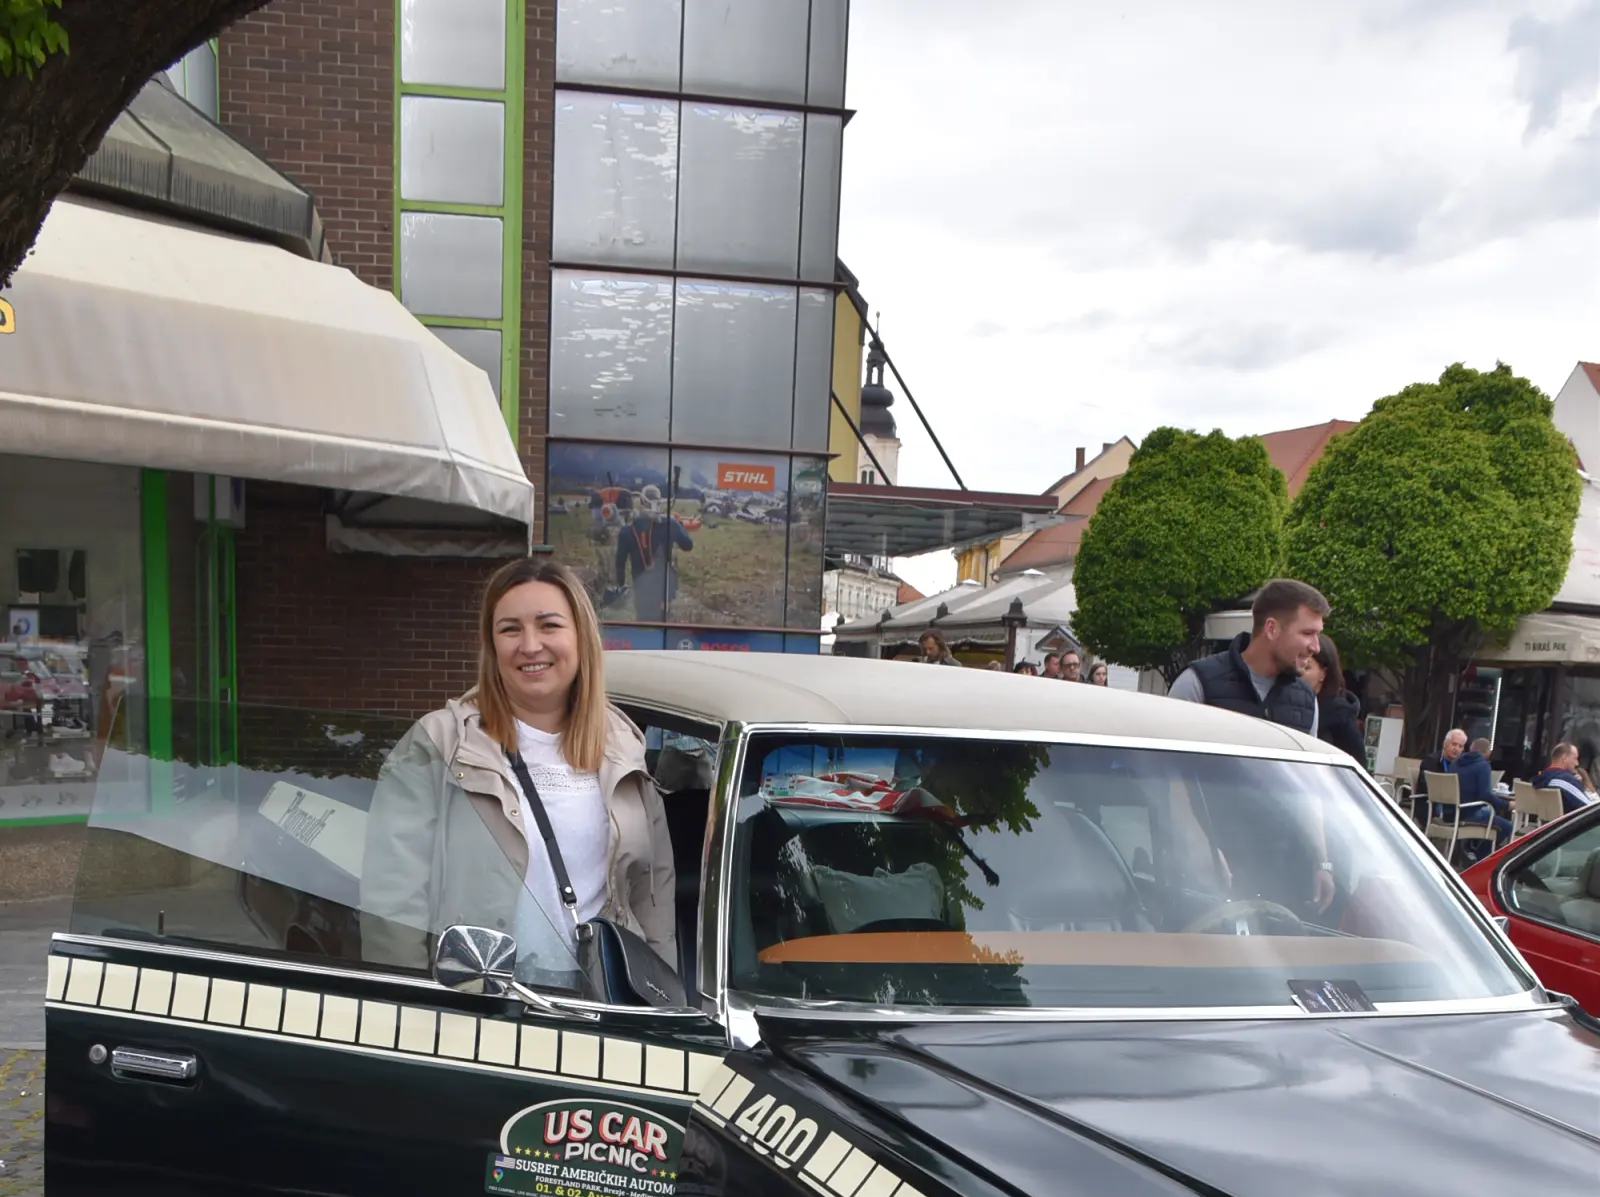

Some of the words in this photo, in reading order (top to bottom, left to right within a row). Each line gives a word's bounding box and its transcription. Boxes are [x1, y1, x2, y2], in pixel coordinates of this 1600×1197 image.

[723, 471, 769, 485] STIHL
[701, 642, 750, 653] BOSCH
[543, 1109, 593, 1144] US
[598, 1112, 668, 1160] CAR
[735, 1093, 819, 1169] 400
[564, 1143, 649, 1173] PICNIC
[515, 1159, 560, 1176] SUSRET
[560, 1167, 628, 1188] AMERIČKIH
[535, 1175, 581, 1189] FORESTLAND
[603, 1187, 626, 1197] Brezje
[535, 1182, 552, 1194] 01.
[554, 1186, 564, 1196] &
